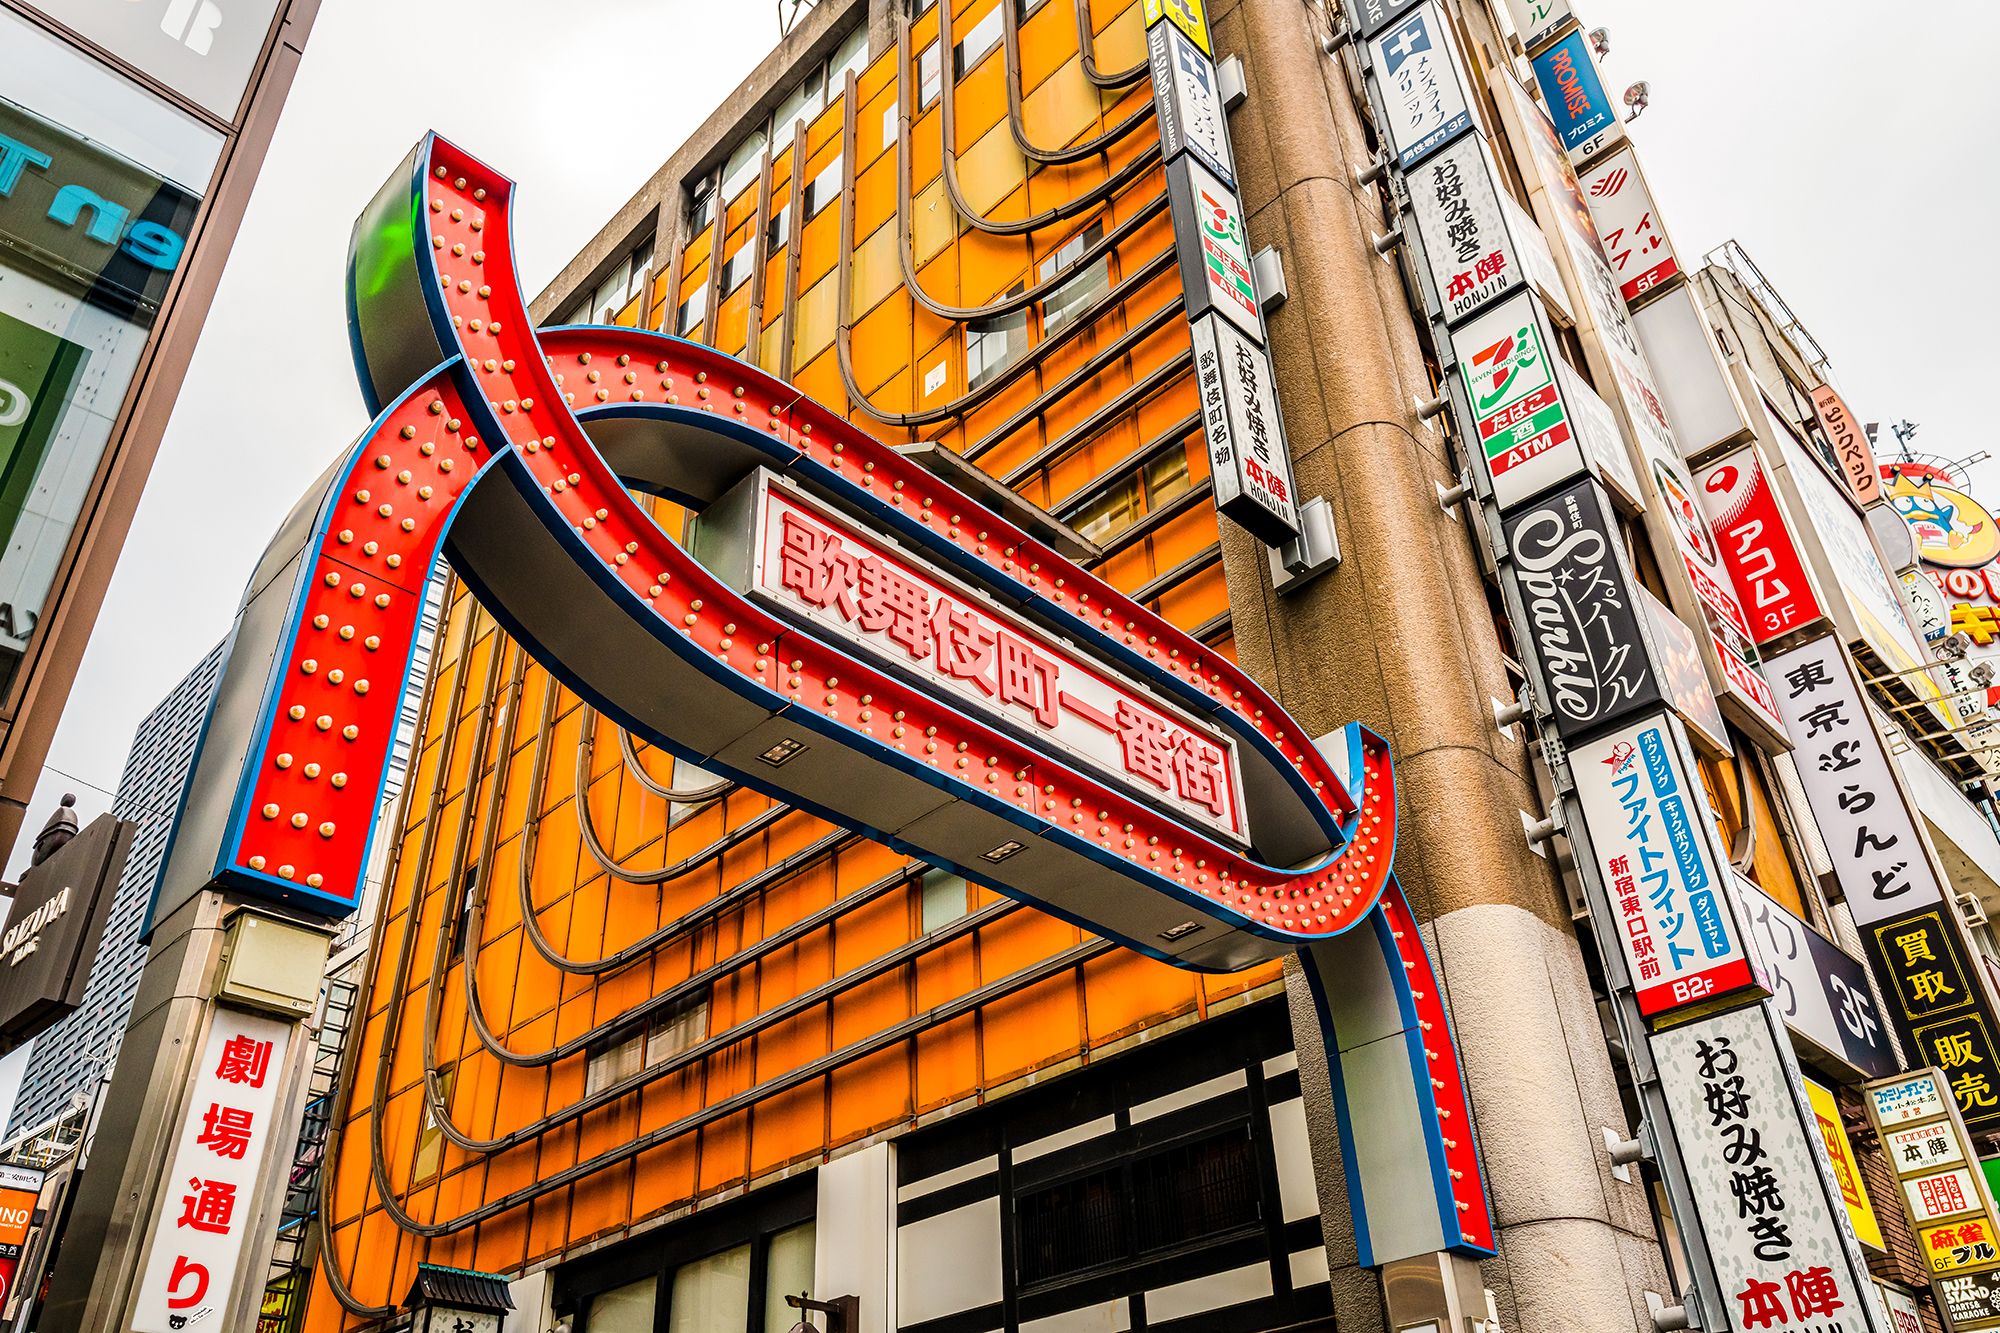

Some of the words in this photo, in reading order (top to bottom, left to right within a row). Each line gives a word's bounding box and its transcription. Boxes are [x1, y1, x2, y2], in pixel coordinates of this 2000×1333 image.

[1150, 26, 1166, 60] BUZZ
[1540, 22, 1558, 39] 7F
[1153, 56, 1171, 97] STAND
[1398, 69, 1423, 129] クリニック
[1417, 56, 1445, 126] メンズライフ
[1549, 48, 1591, 120] PROMISE
[1448, 115, 1466, 132] 3F
[1568, 112, 1605, 141] プロミス
[1582, 133, 1605, 155] 6F
[1433, 159, 1481, 264] お好み焼き
[1220, 280, 1247, 308] ATM
[1446, 249, 1507, 302] 本陣
[1453, 274, 1507, 316] HONJIN
[1637, 270, 1659, 292] 5F
[1501, 345, 1536, 367] HOLDINGS
[1199, 350, 1230, 466] 歌舞伎町名物
[1236, 341, 1270, 463] お好み焼き
[1491, 394, 1546, 432] たばこ
[1507, 433, 1552, 467] ATM
[1511, 419, 1535, 443] 酒
[1825, 406, 1873, 492] ピックペック
[1244, 456, 1289, 503] 本陣
[1250, 482, 1289, 521] HONJIN
[1729, 519, 1790, 609] アコム
[1513, 509, 1606, 721] Sparkle
[1764, 604, 1797, 631] 3F
[1927, 629, 1941, 640] 7F
[1577, 566, 1646, 713] スパークル
[781, 510, 1225, 817] 歌舞伎町一番街
[1643, 731, 1669, 789] ボクシング
[1784, 659, 1911, 900] 東京ぶらんど
[1664, 800, 1700, 888] キックボクシング
[1611, 772, 1695, 971] ファイトフィット
[1608, 854, 1662, 981] 新宿東口駅前
[1696, 895, 1724, 953] ダイエット
[1672, 976, 1714, 1002] B2F
[1895, 928, 1955, 1003] 買取
[1830, 973, 1877, 1048] 3F
[1933, 1031, 1999, 1113] 販売
[167, 1034, 273, 1309] 劇場通り
[1695, 1036, 1793, 1262] お好み焼き
[1902, 1137, 1949, 1162] 本陣
[1929, 1222, 1986, 1250] 麻雀
[1951, 1242, 1996, 1265] ブル
[1934, 1256, 1952, 1270] 6F
[1940, 1276, 1976, 1293] BUZZ
[1736, 1265, 1845, 1330] 本陣
[1945, 1286, 1990, 1304] STAND
[1952, 1307, 1990, 1321] KARAOKE
